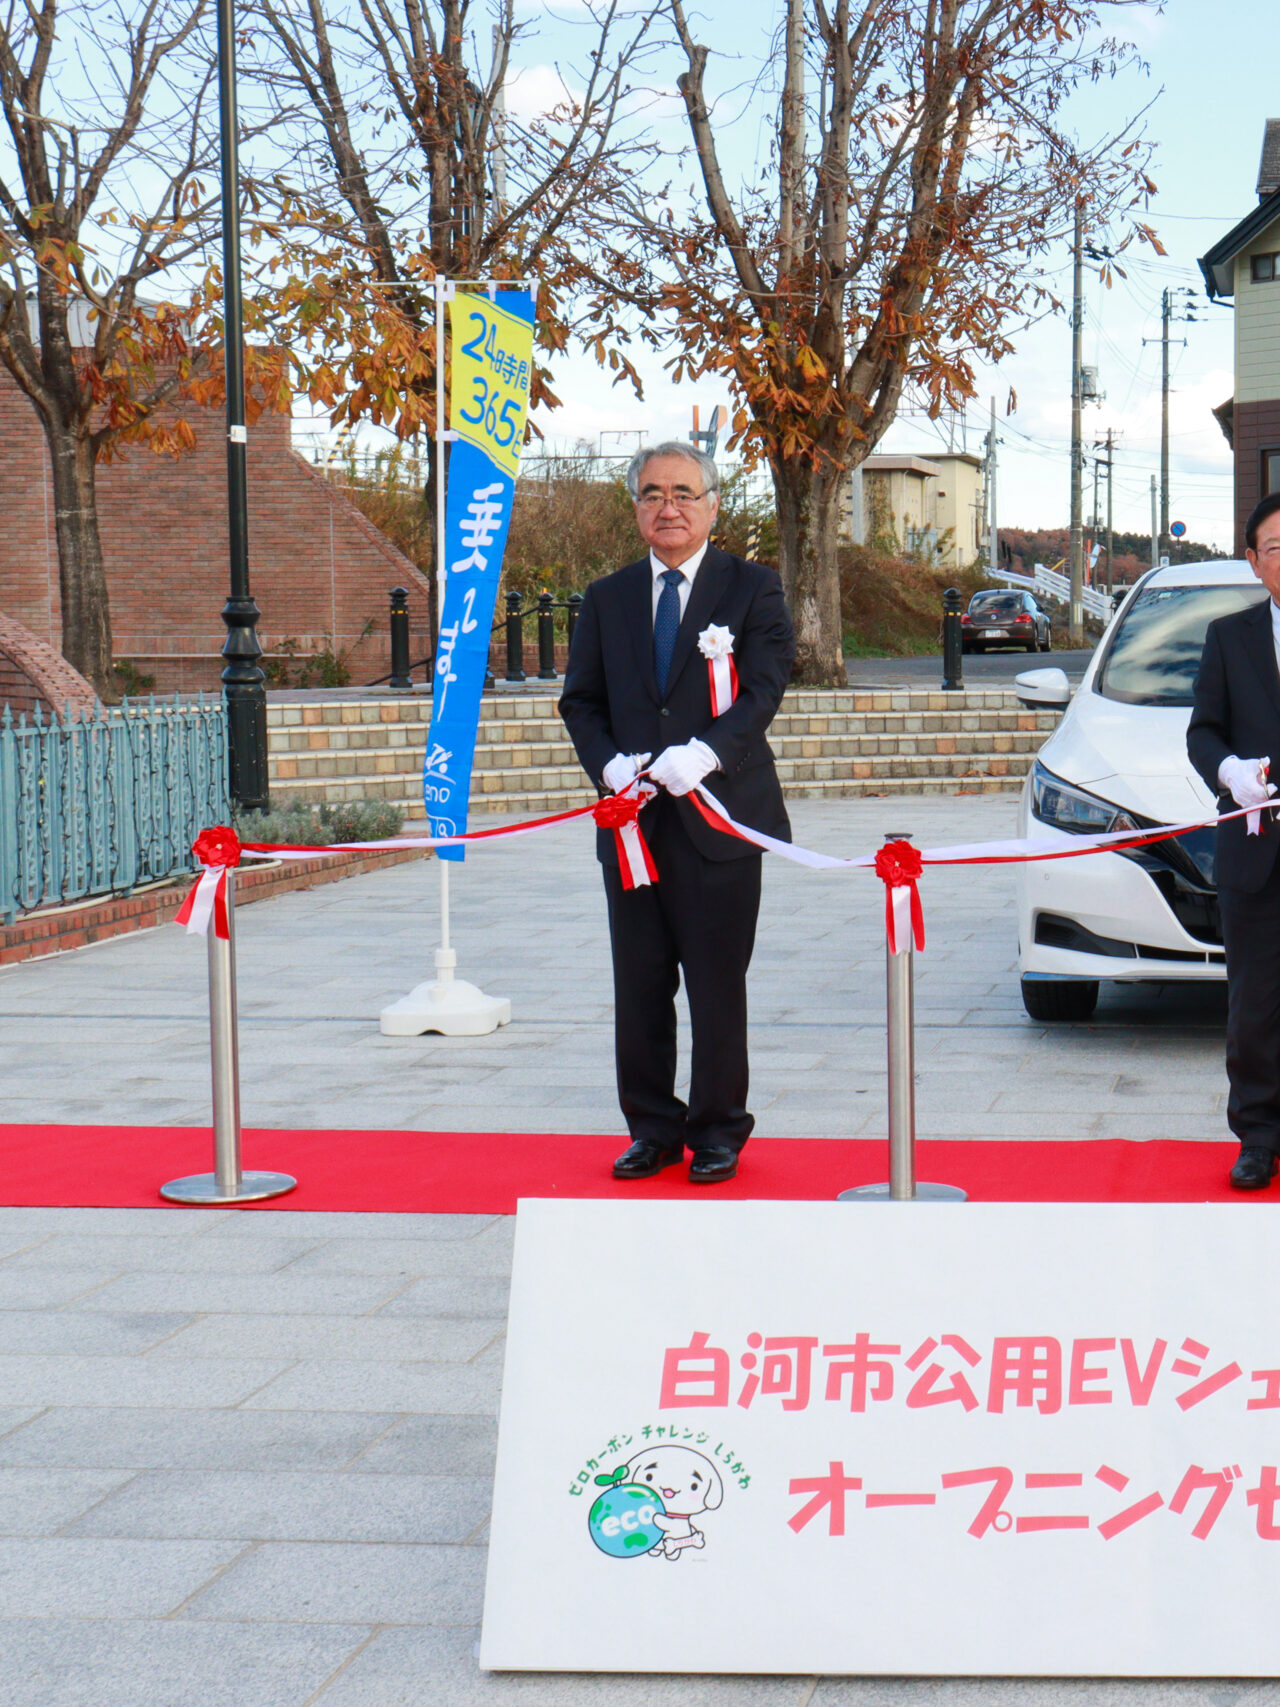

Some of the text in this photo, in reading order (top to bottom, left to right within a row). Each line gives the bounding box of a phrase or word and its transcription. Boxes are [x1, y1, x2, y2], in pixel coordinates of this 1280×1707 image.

[568, 1424, 752, 1497] ゼロカーボン チャレンジ しらかわ
[601, 1504, 656, 1537] eco
